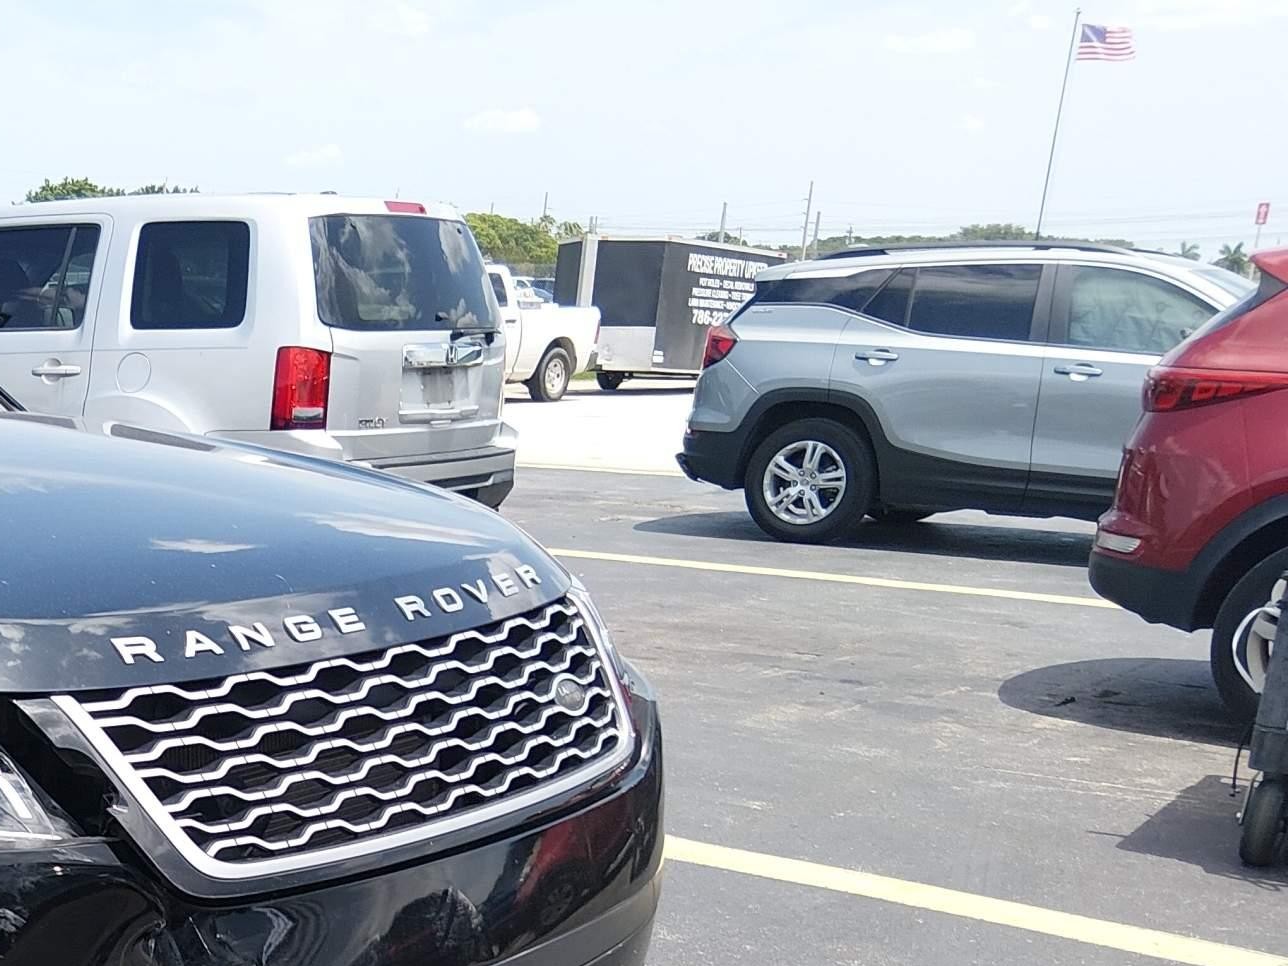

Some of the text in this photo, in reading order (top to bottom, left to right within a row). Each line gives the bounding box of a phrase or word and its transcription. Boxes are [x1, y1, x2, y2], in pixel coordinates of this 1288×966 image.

[687, 253, 715, 274] PRECISE
[713, 256, 746, 278] PROPERTY
[110, 563, 542, 665] RANGE ROVER
